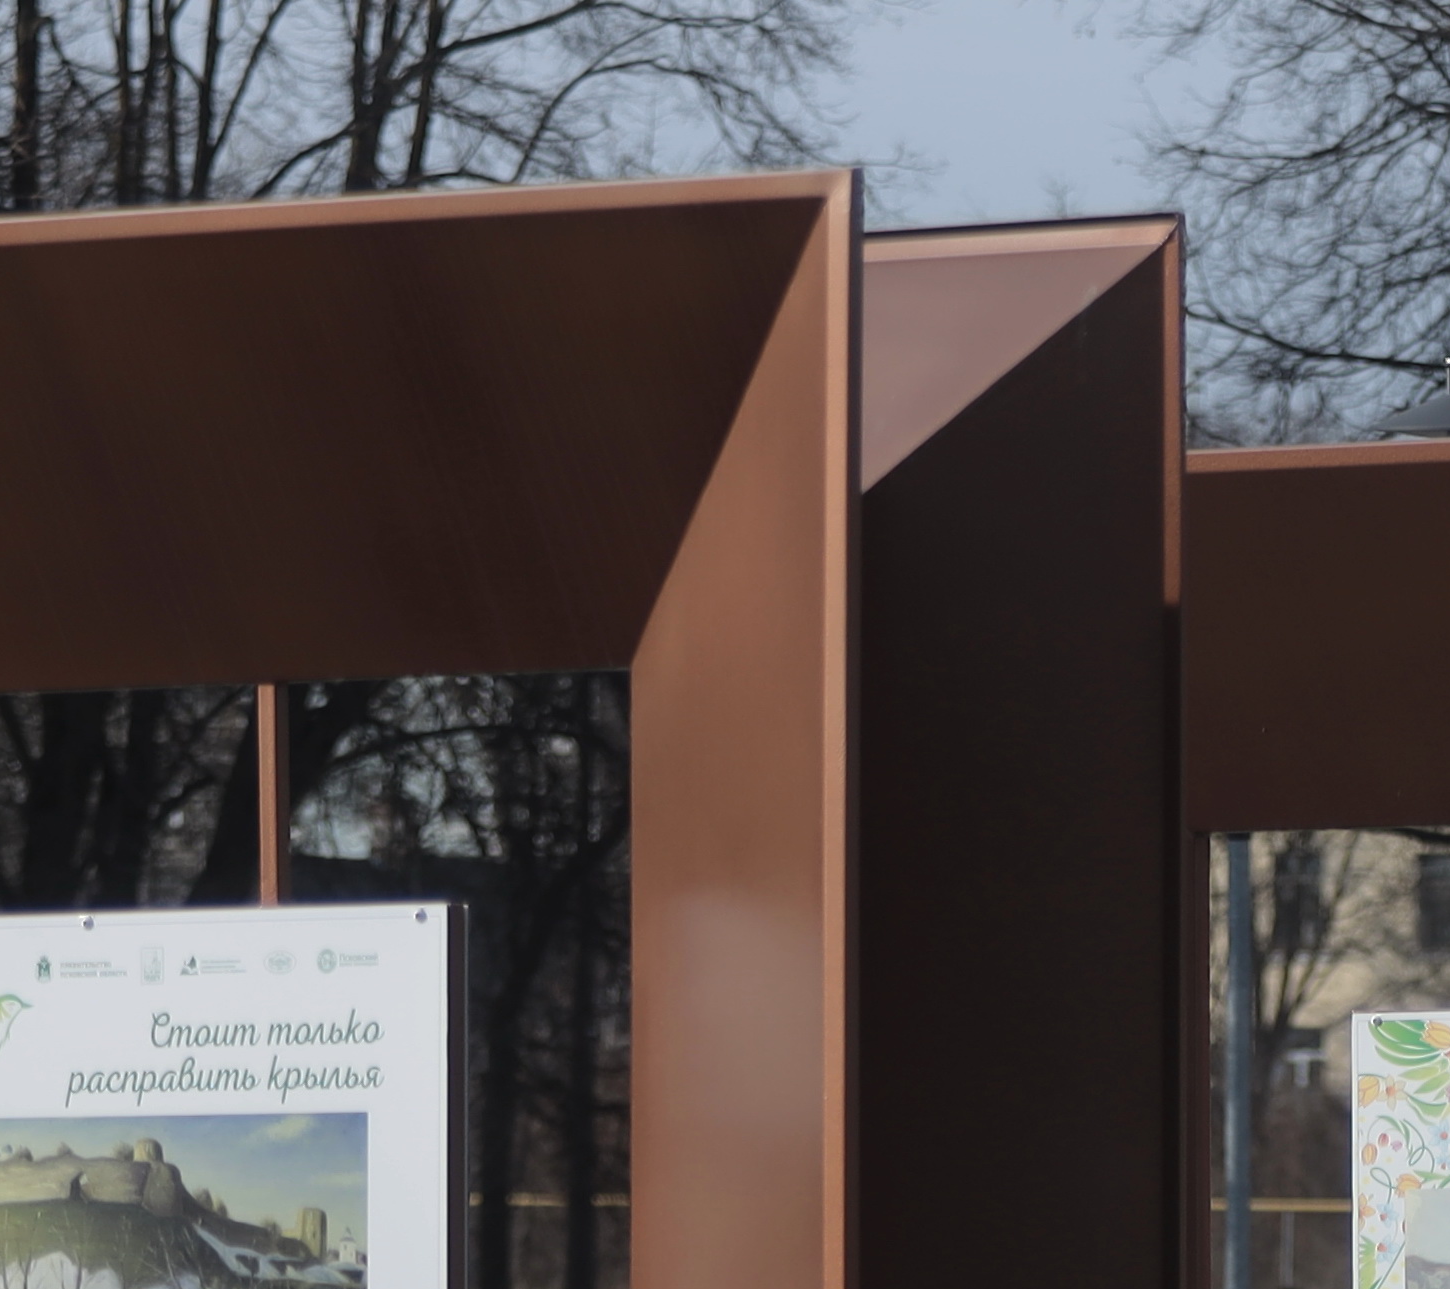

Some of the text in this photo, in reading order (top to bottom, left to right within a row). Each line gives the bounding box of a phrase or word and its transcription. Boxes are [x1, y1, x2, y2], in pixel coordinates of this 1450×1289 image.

[151, 1008, 385, 1048] Стоит только
[65, 1054, 385, 1108] расправить крылья
